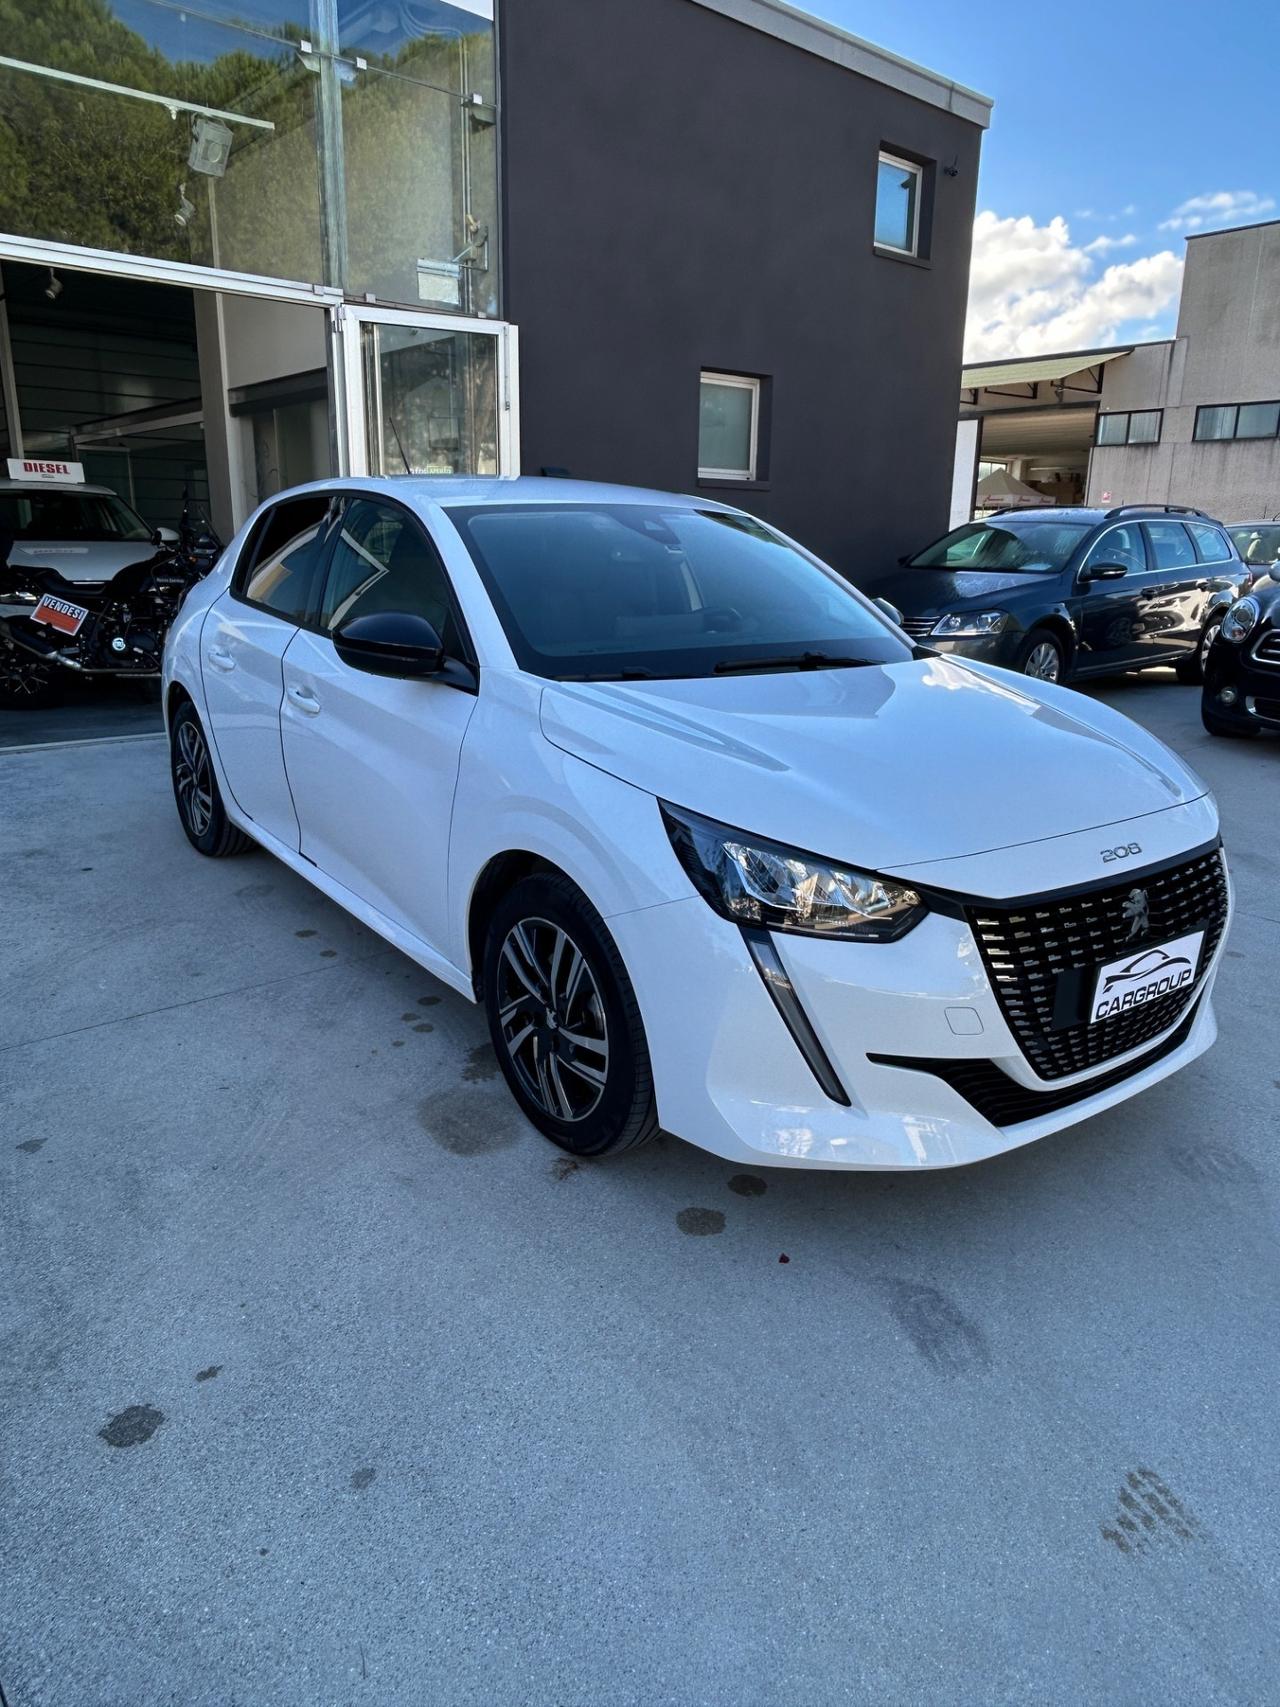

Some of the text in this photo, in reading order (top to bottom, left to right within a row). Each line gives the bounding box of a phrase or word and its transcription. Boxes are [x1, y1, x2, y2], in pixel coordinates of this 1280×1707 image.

[23, 462, 71, 475] DIESEL
[43, 597, 84, 620] VENDESI
[1100, 842, 1143, 864] 208
[1095, 968, 1192, 1020] CARGROUP
